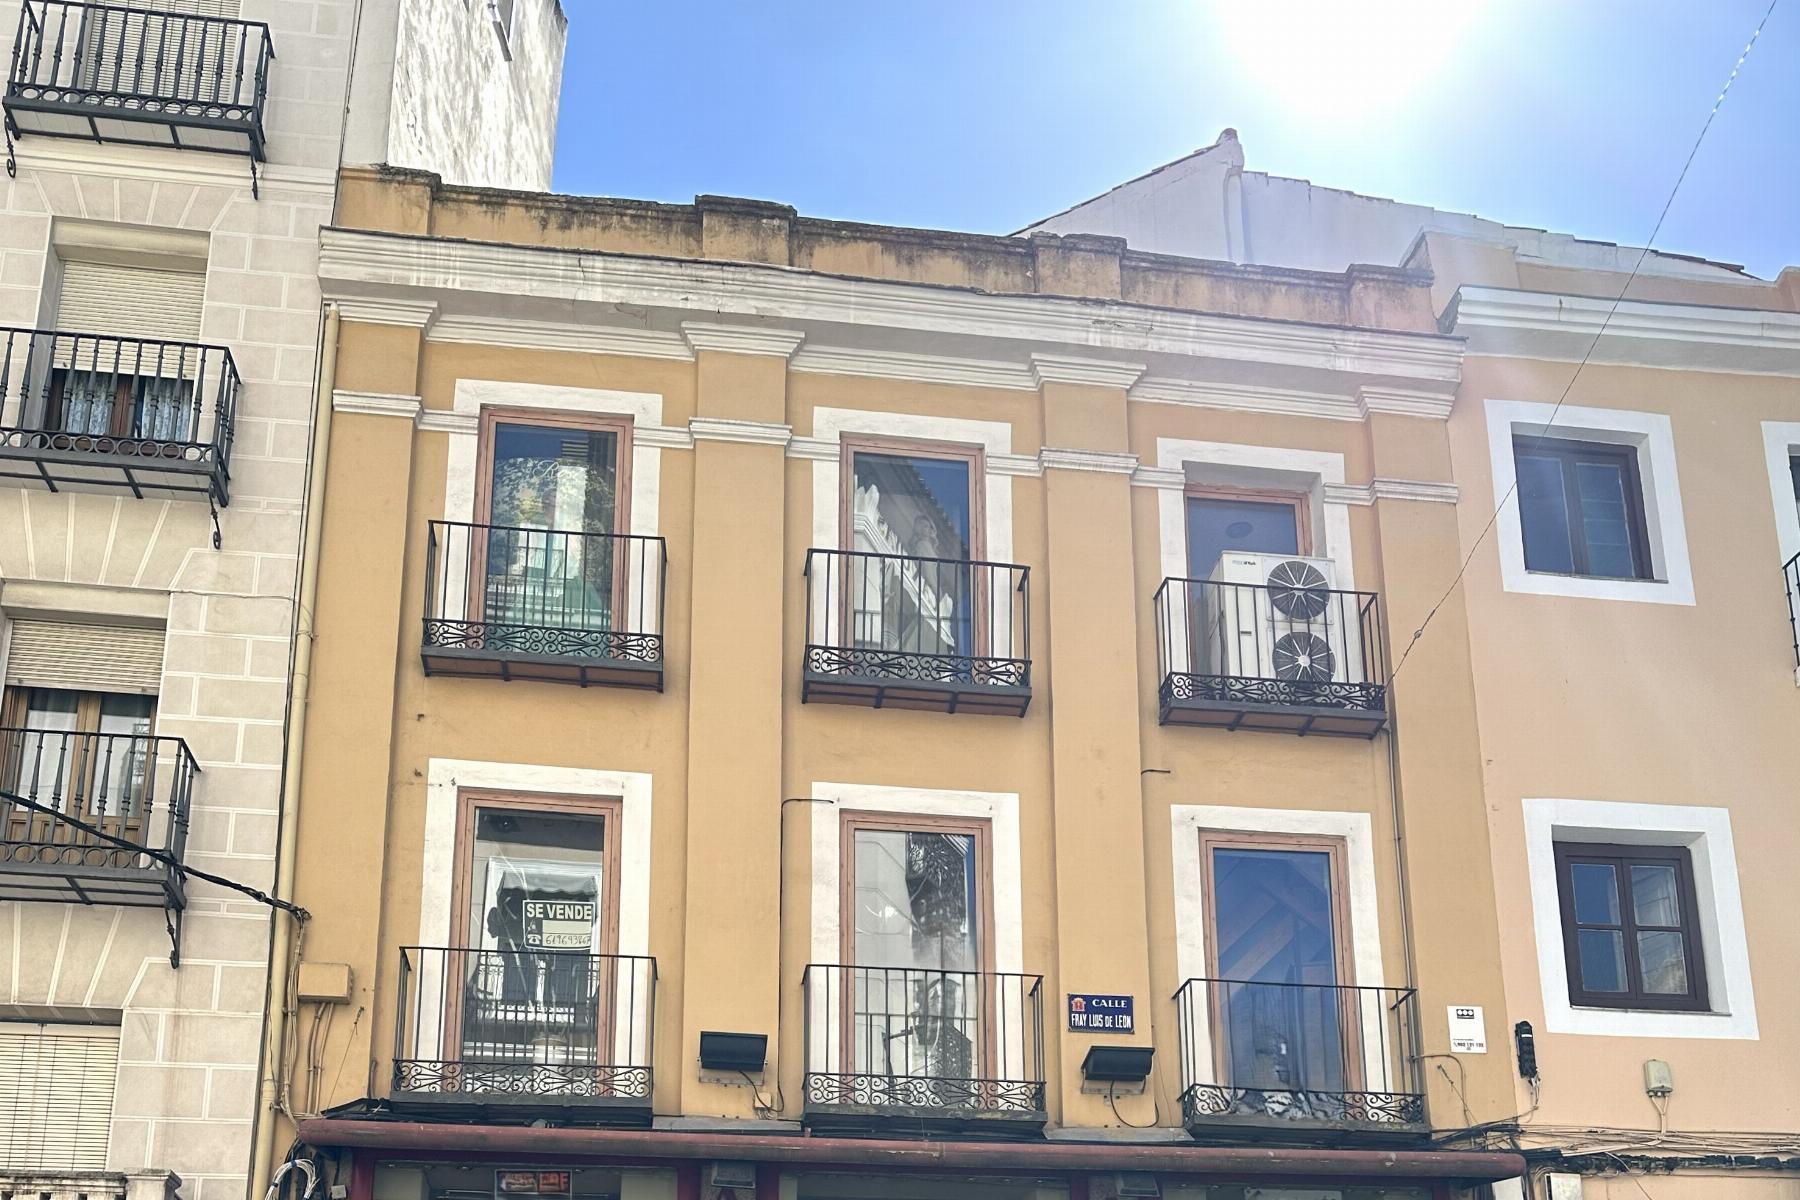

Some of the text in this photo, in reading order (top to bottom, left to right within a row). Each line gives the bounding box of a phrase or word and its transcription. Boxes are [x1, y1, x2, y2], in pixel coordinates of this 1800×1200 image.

[526, 903, 592, 919] SE VENDE
[1092, 999, 1127, 1007] CALLE
[1071, 1013, 1087, 1027] FRAY
[1088, 1013, 1103, 1027] LUIS
[1105, 1015, 1113, 1027] DE
